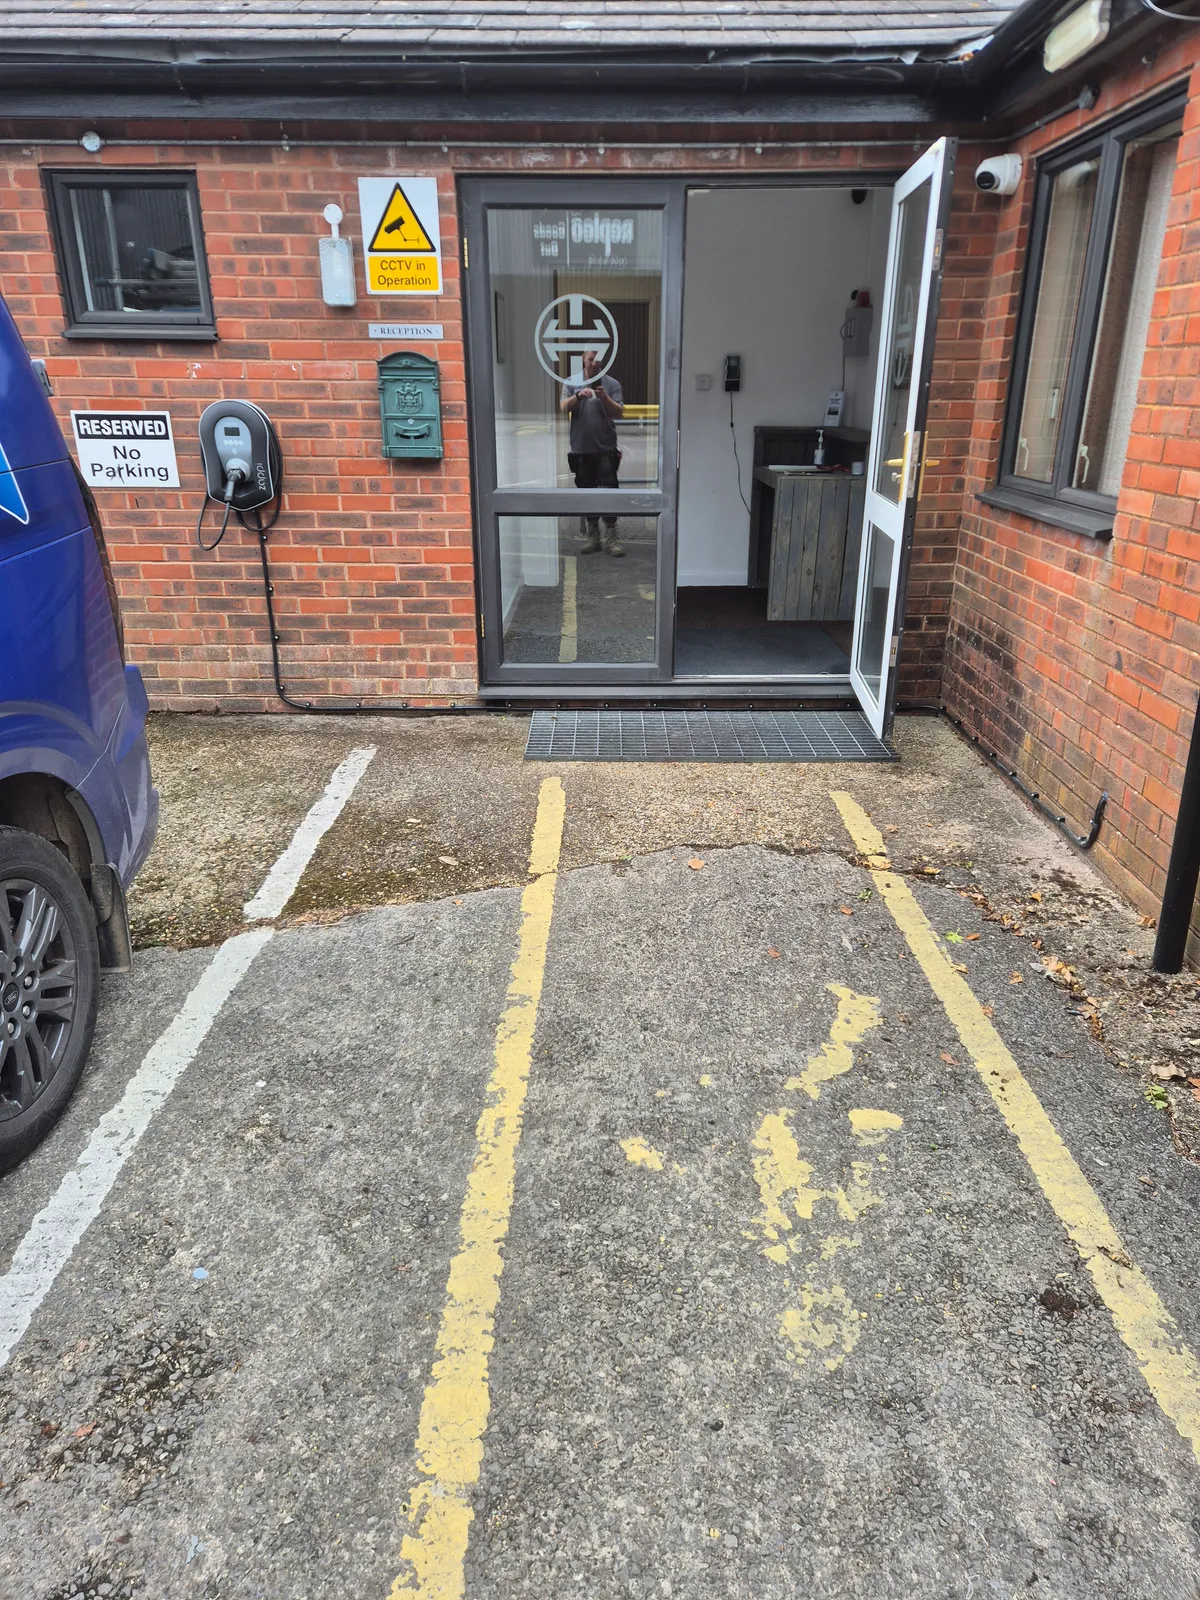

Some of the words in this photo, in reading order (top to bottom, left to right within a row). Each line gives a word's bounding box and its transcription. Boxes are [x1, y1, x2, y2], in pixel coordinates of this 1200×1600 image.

[380, 260, 412, 271] CCTV
[416, 260, 426, 271] in
[377, 275, 432, 288] Operation
[380, 327, 433, 335] RECEPTION
[78, 419, 166, 436] RESERVED
[112, 445, 141, 460] No
[90, 463, 169, 482] Parking
[254, 462, 267, 491] zappi
